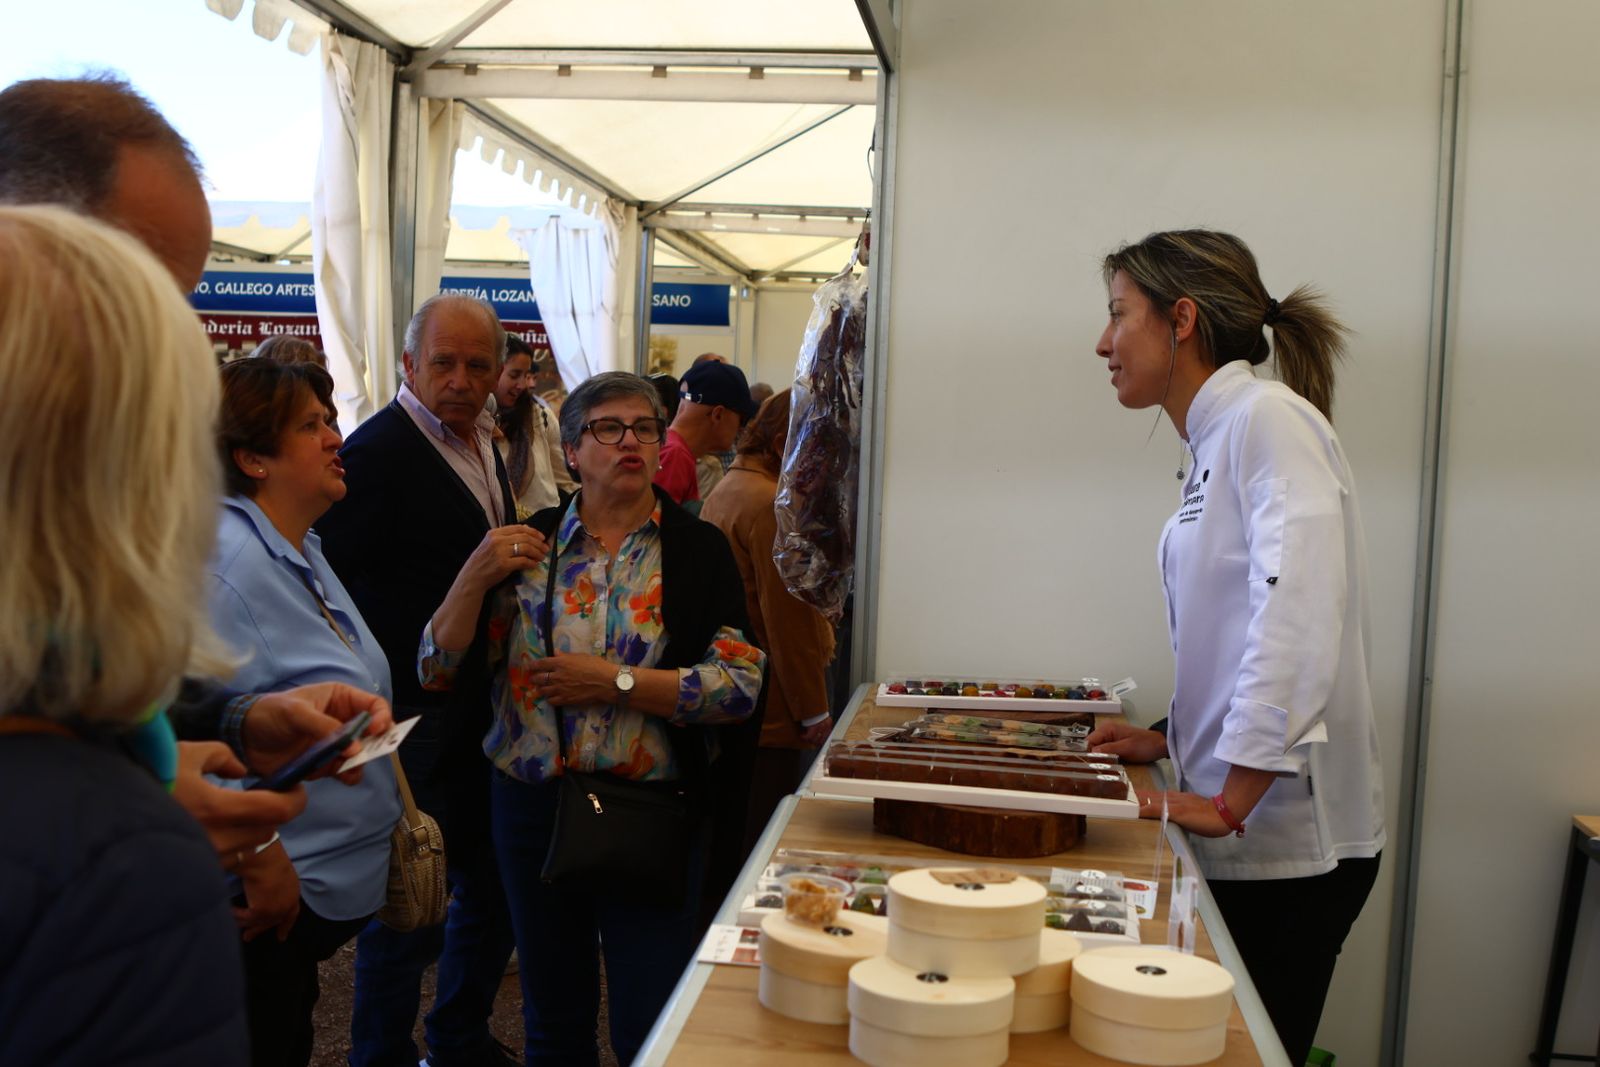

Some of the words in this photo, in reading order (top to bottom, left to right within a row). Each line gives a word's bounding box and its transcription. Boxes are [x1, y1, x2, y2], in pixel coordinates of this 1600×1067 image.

[215, 282, 273, 296] GALLEGO
[275, 283, 315, 297] ARTES
[492, 289, 537, 303] LOZAN
[652, 294, 692, 307] SANO
[258, 321, 320, 336] Lozan
